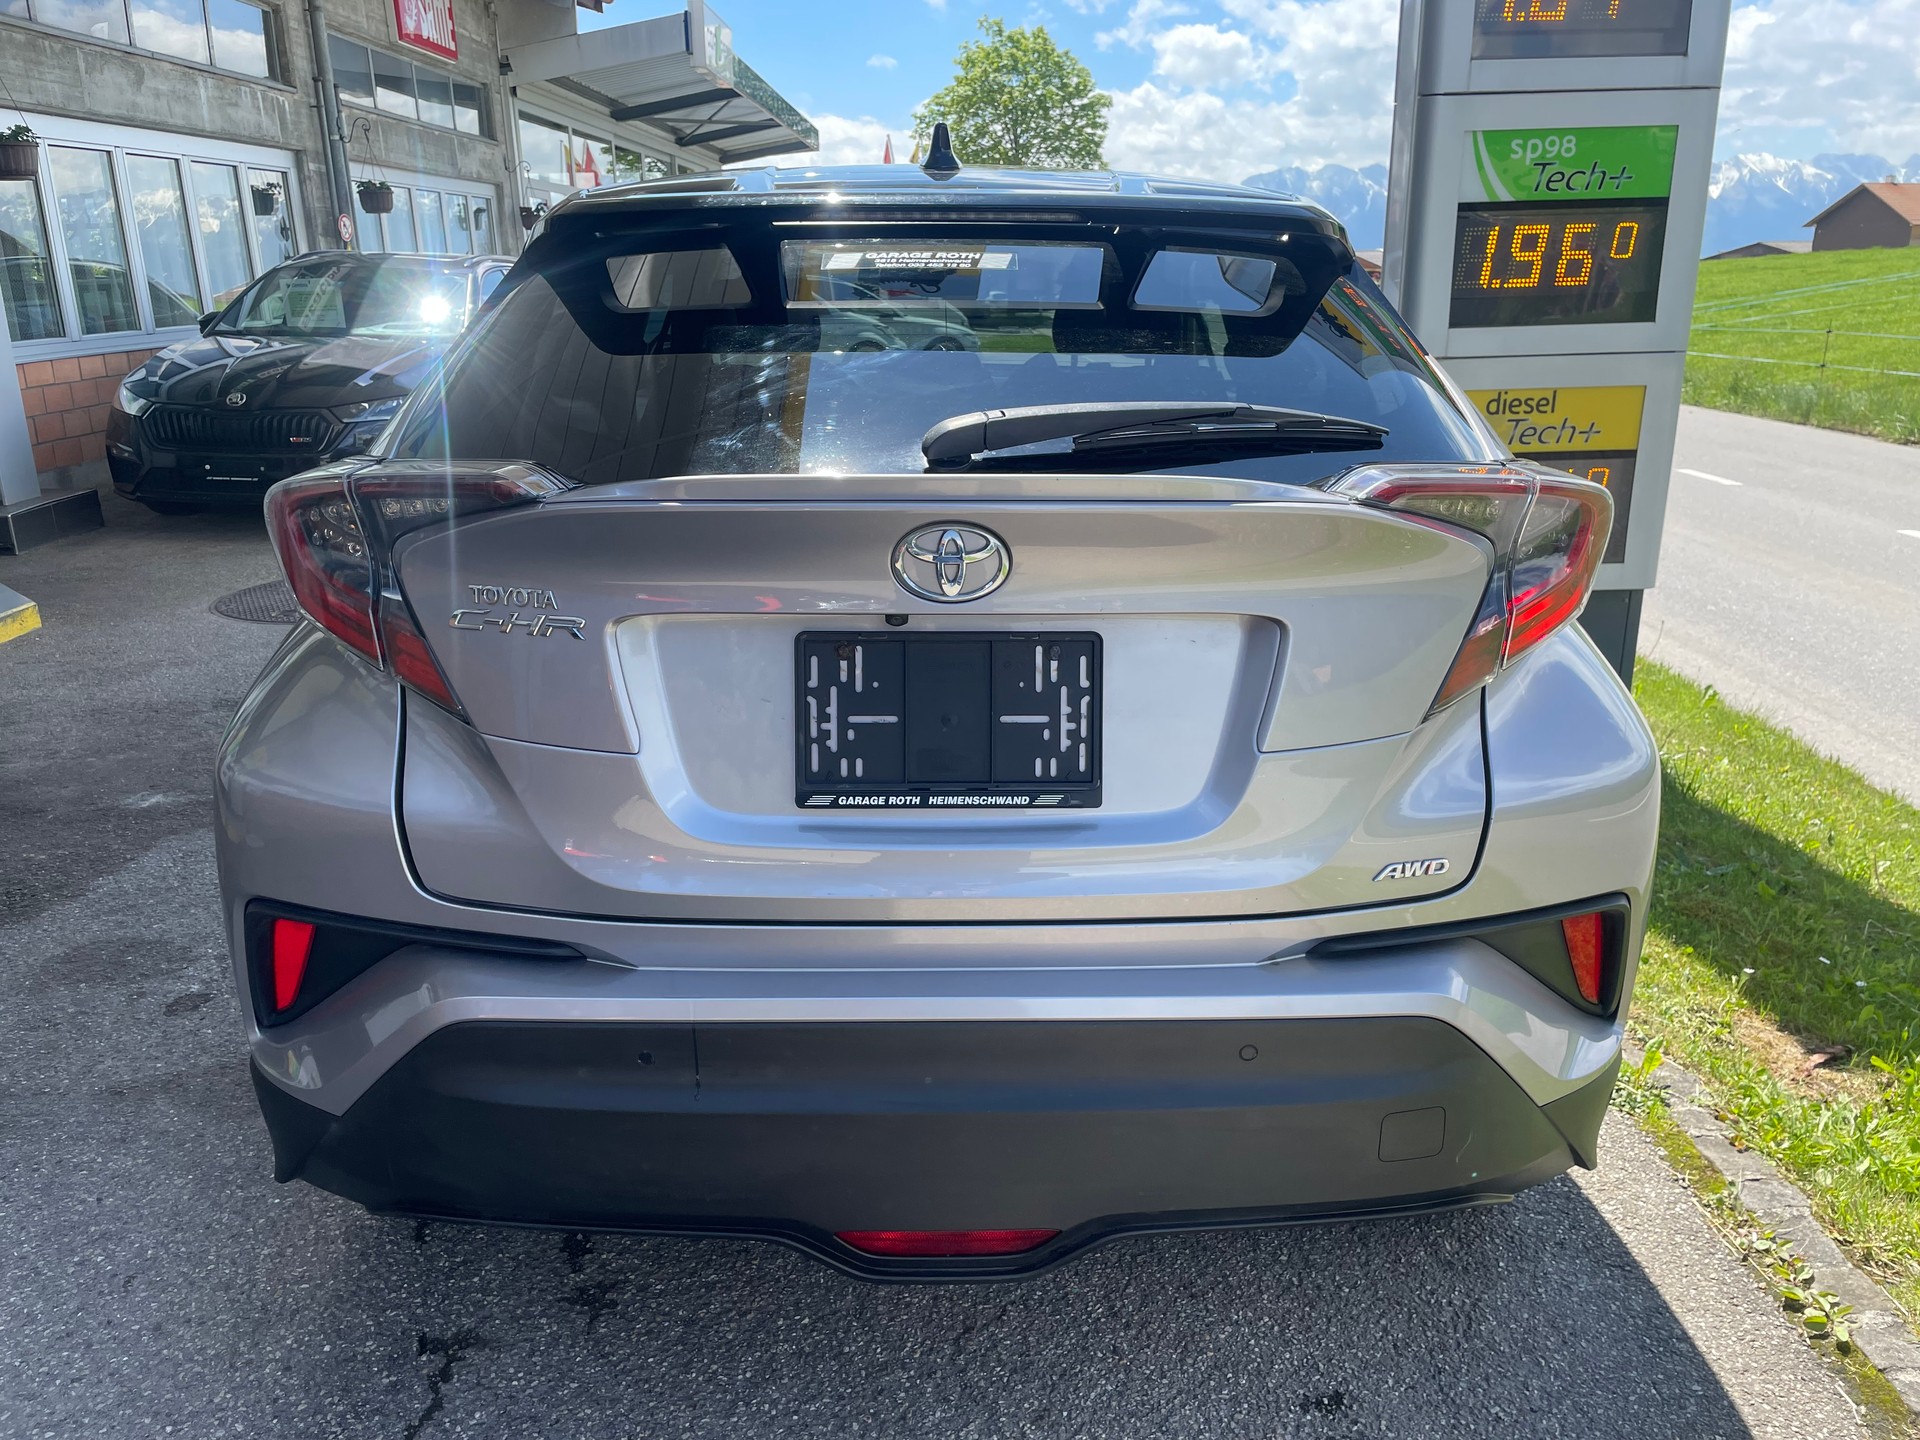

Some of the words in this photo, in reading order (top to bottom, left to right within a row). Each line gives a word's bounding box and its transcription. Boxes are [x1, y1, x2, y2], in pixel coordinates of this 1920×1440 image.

[1510, 135, 1577, 166] sp98
[1532, 160, 1633, 193] Tech+
[1486, 390, 1557, 415] diesel
[1507, 417, 1602, 446] Tech+
[468, 584, 558, 610] TOYOTA
[449, 609, 586, 641] C-HR
[838, 796, 886, 805] GARAGE
[888, 796, 920, 805] ROTH
[928, 796, 1030, 805] HEIMENSCHWAND
[1371, 858, 1450, 882] AWD
